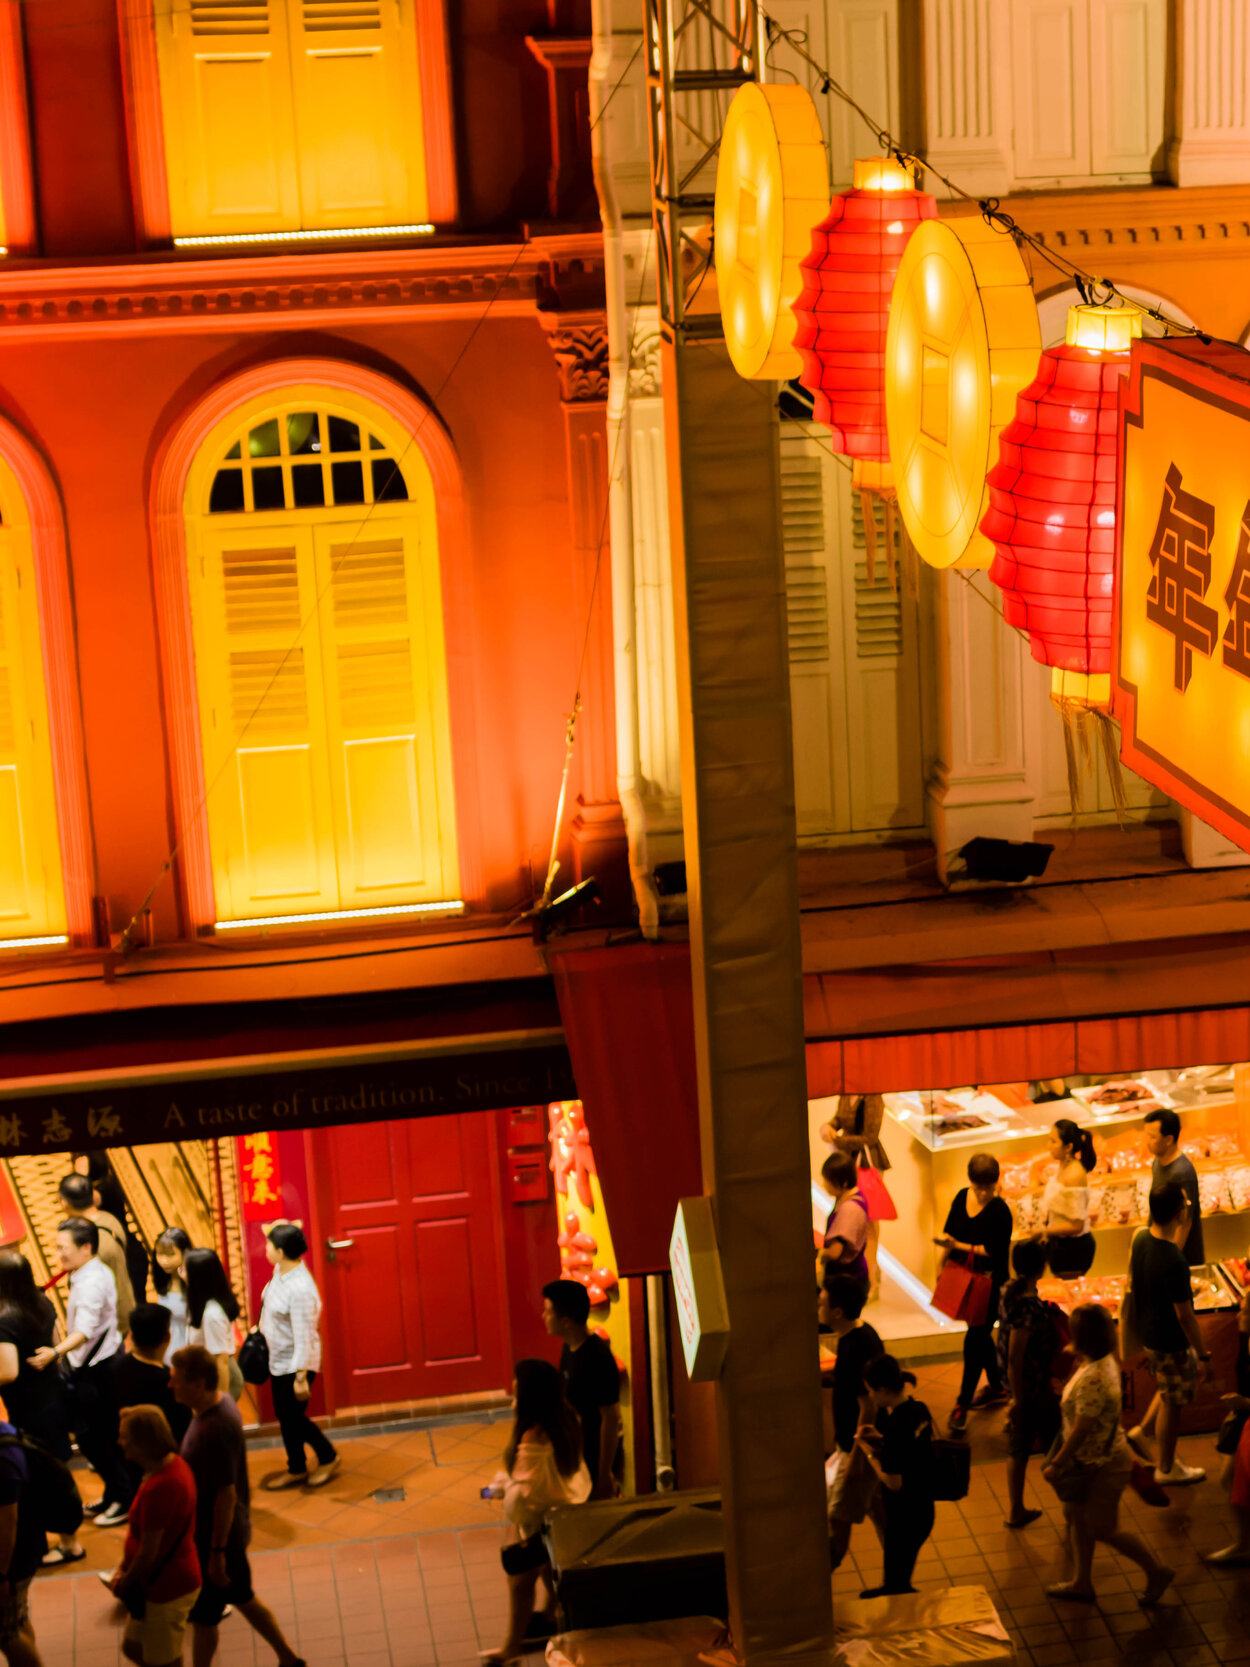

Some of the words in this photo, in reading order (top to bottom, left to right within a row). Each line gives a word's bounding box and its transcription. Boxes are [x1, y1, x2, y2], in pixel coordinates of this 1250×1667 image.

[164, 1101, 187, 1128] A
[198, 1101, 264, 1126] taste
[272, 1087, 304, 1118] of
[455, 1072, 532, 1101] Since
